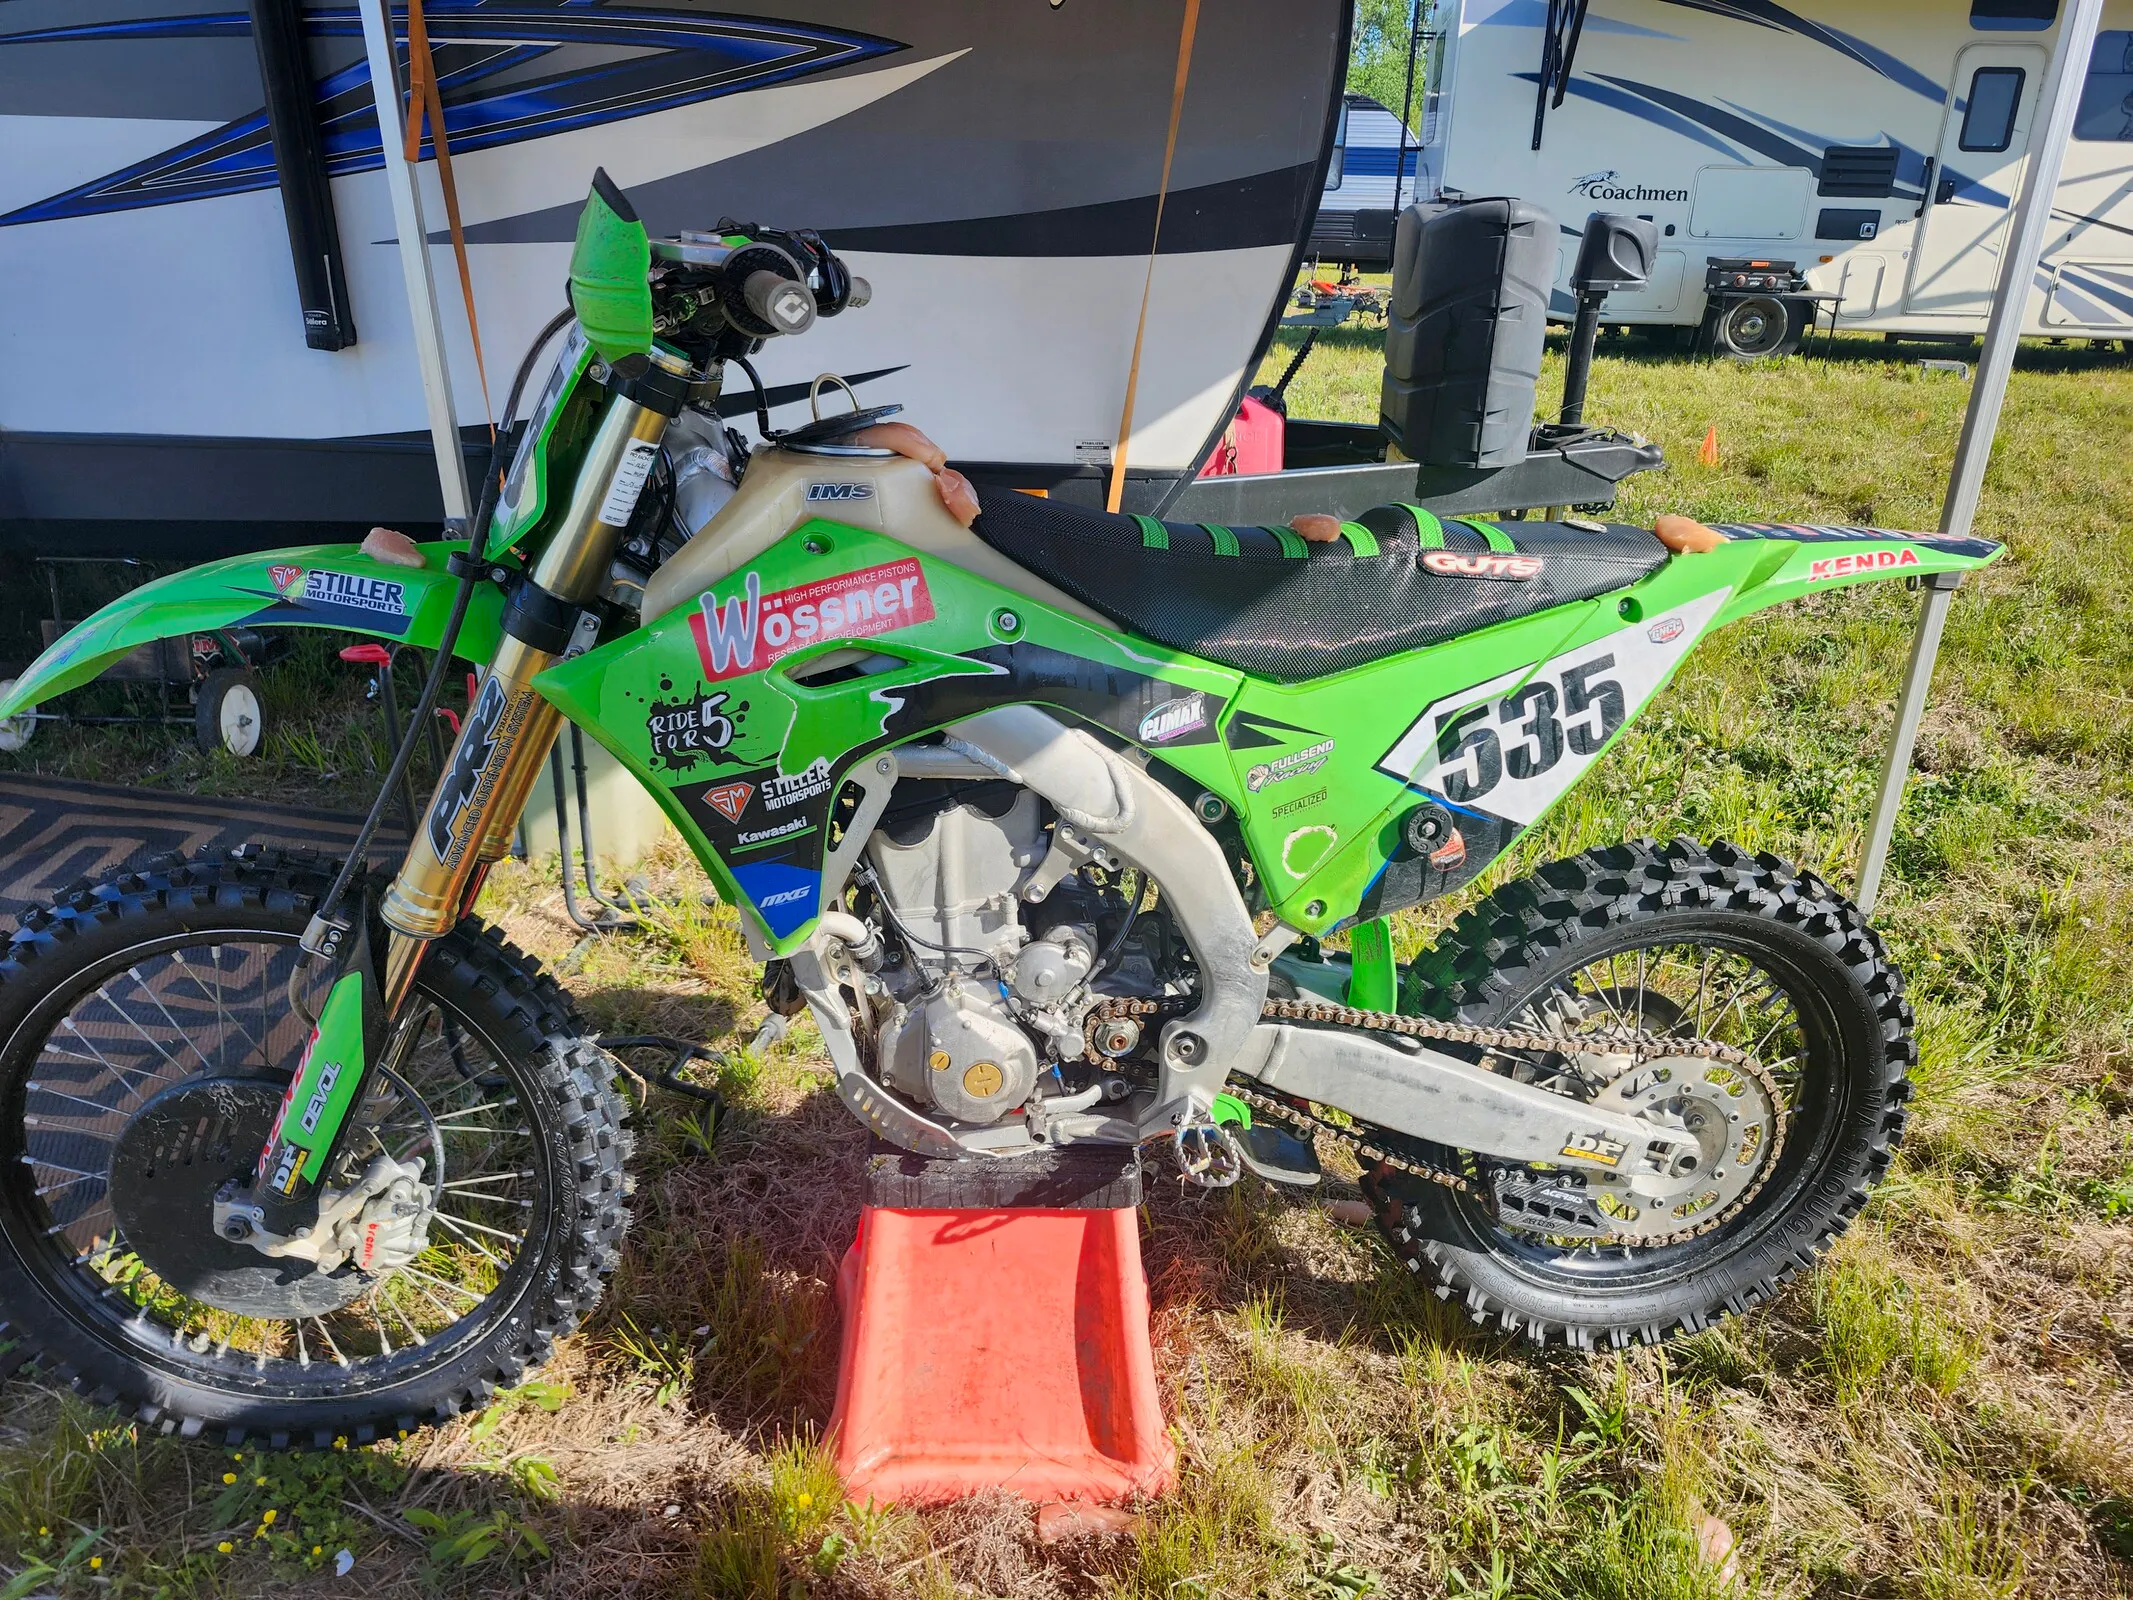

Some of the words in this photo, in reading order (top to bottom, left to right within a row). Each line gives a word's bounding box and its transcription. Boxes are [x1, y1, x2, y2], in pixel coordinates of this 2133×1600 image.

[1590, 185, 1688, 201] Coachmen
[807, 483, 875, 501] IMS
[1423, 552, 1544, 577] GUTS
[1808, 548, 1920, 582] KENDA
[307, 570, 403, 603] STILLER
[784, 591, 807, 604] HIGH
[809, 572, 876, 598] PERFORMANCE
[878, 562, 916, 580] PISTONS
[305, 589, 402, 613] MOTORSPORTS
[700, 571, 918, 673] Wössner
[650, 710, 699, 734] RIDE
[702, 694, 733, 748] 5
[1141, 699, 1202, 740] CLIMAX
[1435, 653, 1626, 803] 535
[654, 730, 700, 754] FOR
[1271, 739, 1334, 771] FULLSEND
[428, 676, 507, 866] PR2
[448, 807, 482, 871] ADVANCED
[475, 735, 515, 808] SUSPENSION
[507, 691, 535, 735] SYSTEM
[761, 764, 830, 799] STILLER
[1264, 756, 1328, 787] Racing
[765, 779, 832, 811] MOTORSPORTS
[1272, 791, 1327, 819] SPECIALIZED
[738, 816, 808, 844] Kawasaki
[760, 885, 812, 908] MXG
[300, 1061, 342, 1136] DEVOL
[1566, 1134, 1624, 1158] DP
[272, 1144, 296, 1192] DP
